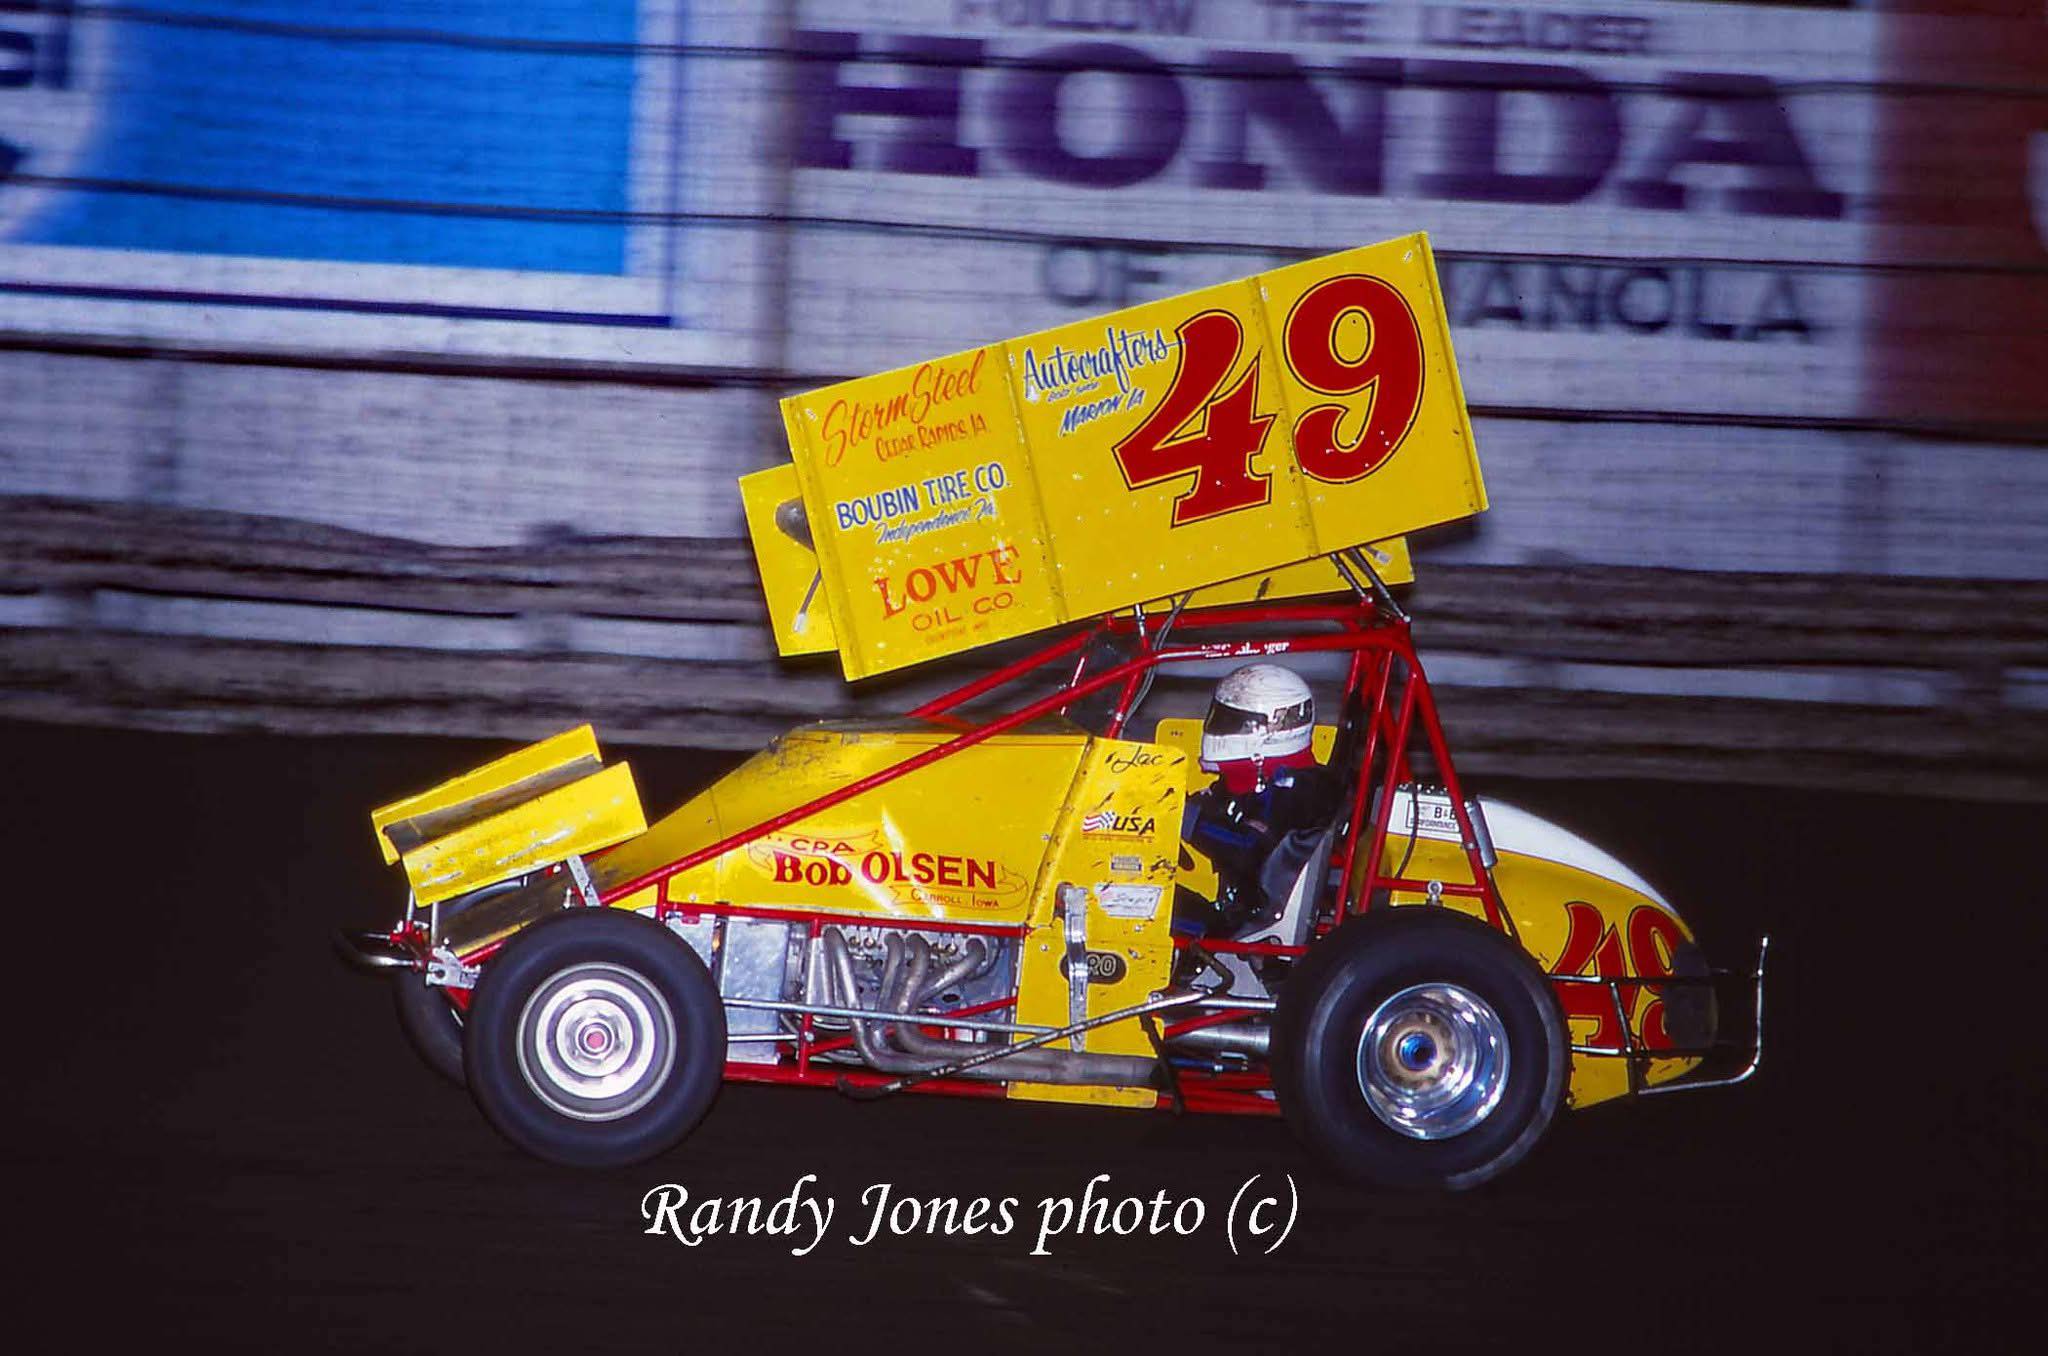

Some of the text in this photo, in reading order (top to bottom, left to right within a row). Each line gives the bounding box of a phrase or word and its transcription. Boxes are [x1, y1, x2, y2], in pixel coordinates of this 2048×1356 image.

[1420, 9, 1651, 55] LEADER
[795, 30, 1844, 220] HONDA
[1042, 240, 1168, 308] OF
[1024, 327, 1187, 398] Autocrafters
[822, 350, 986, 467] Storm Steel
[1112, 273, 1425, 529] 49
[836, 462, 1012, 530] BOUBIN TIRE CO.
[874, 544, 1022, 620] LOWE
[912, 592, 1013, 631] OIL CO
[789, 838, 856, 854] CPA
[1112, 815, 1156, 836] USA
[861, 851, 997, 889] OLSEN
[1087, 953, 1117, 977] RO
